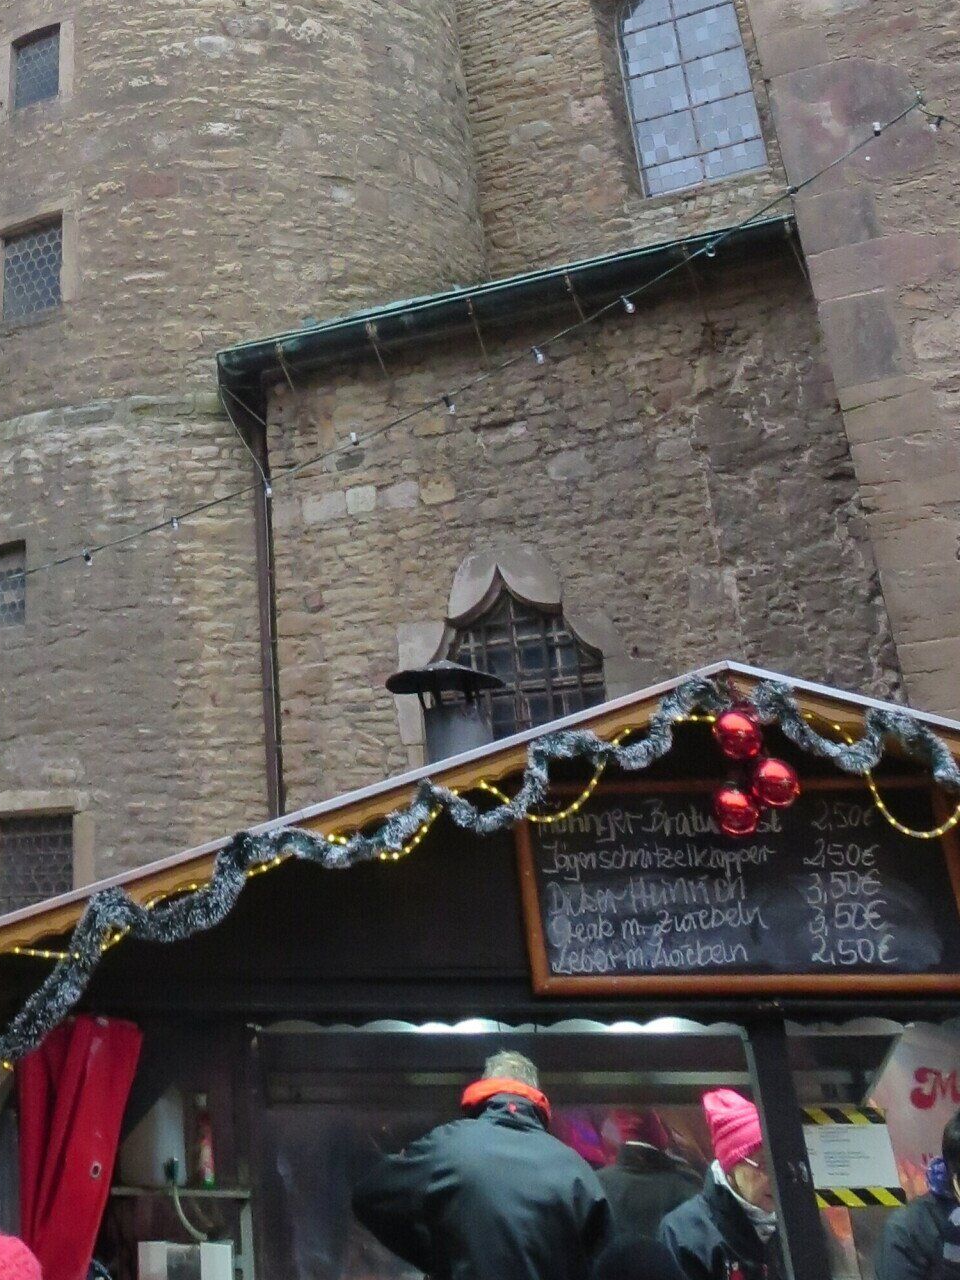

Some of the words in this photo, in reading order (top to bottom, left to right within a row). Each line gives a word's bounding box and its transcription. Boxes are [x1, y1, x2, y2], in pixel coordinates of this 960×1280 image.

[811, 800, 876, 831] 2,50€
[806, 868, 883, 904] 3,50€
[809, 899, 888, 937] 3,50€
[810, 933, 900, 966] 2,50€
